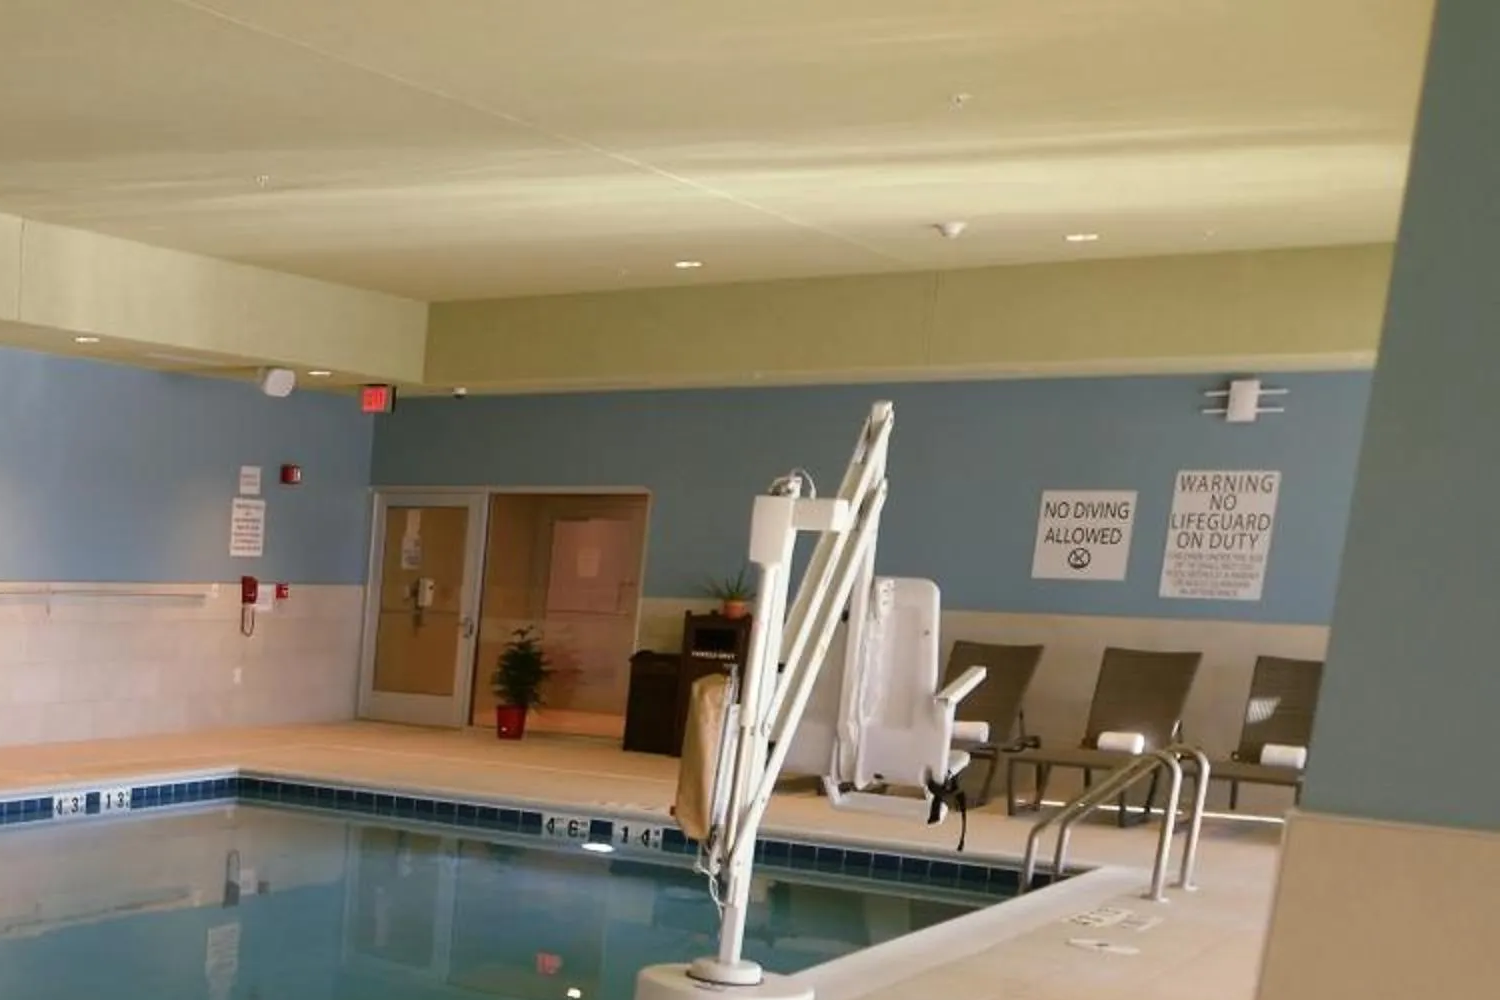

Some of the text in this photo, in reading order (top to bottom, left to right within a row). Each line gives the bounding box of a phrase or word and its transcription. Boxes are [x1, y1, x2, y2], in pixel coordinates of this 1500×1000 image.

[1179, 474, 1275, 494] WARNING
[1044, 501, 1130, 520] NO DIVING
[1209, 494, 1237, 511] NO
[1170, 512, 1272, 531] LIFEGUARD
[1044, 527, 1122, 545] ALLOWED
[1177, 531, 1260, 550] ON DUTY
